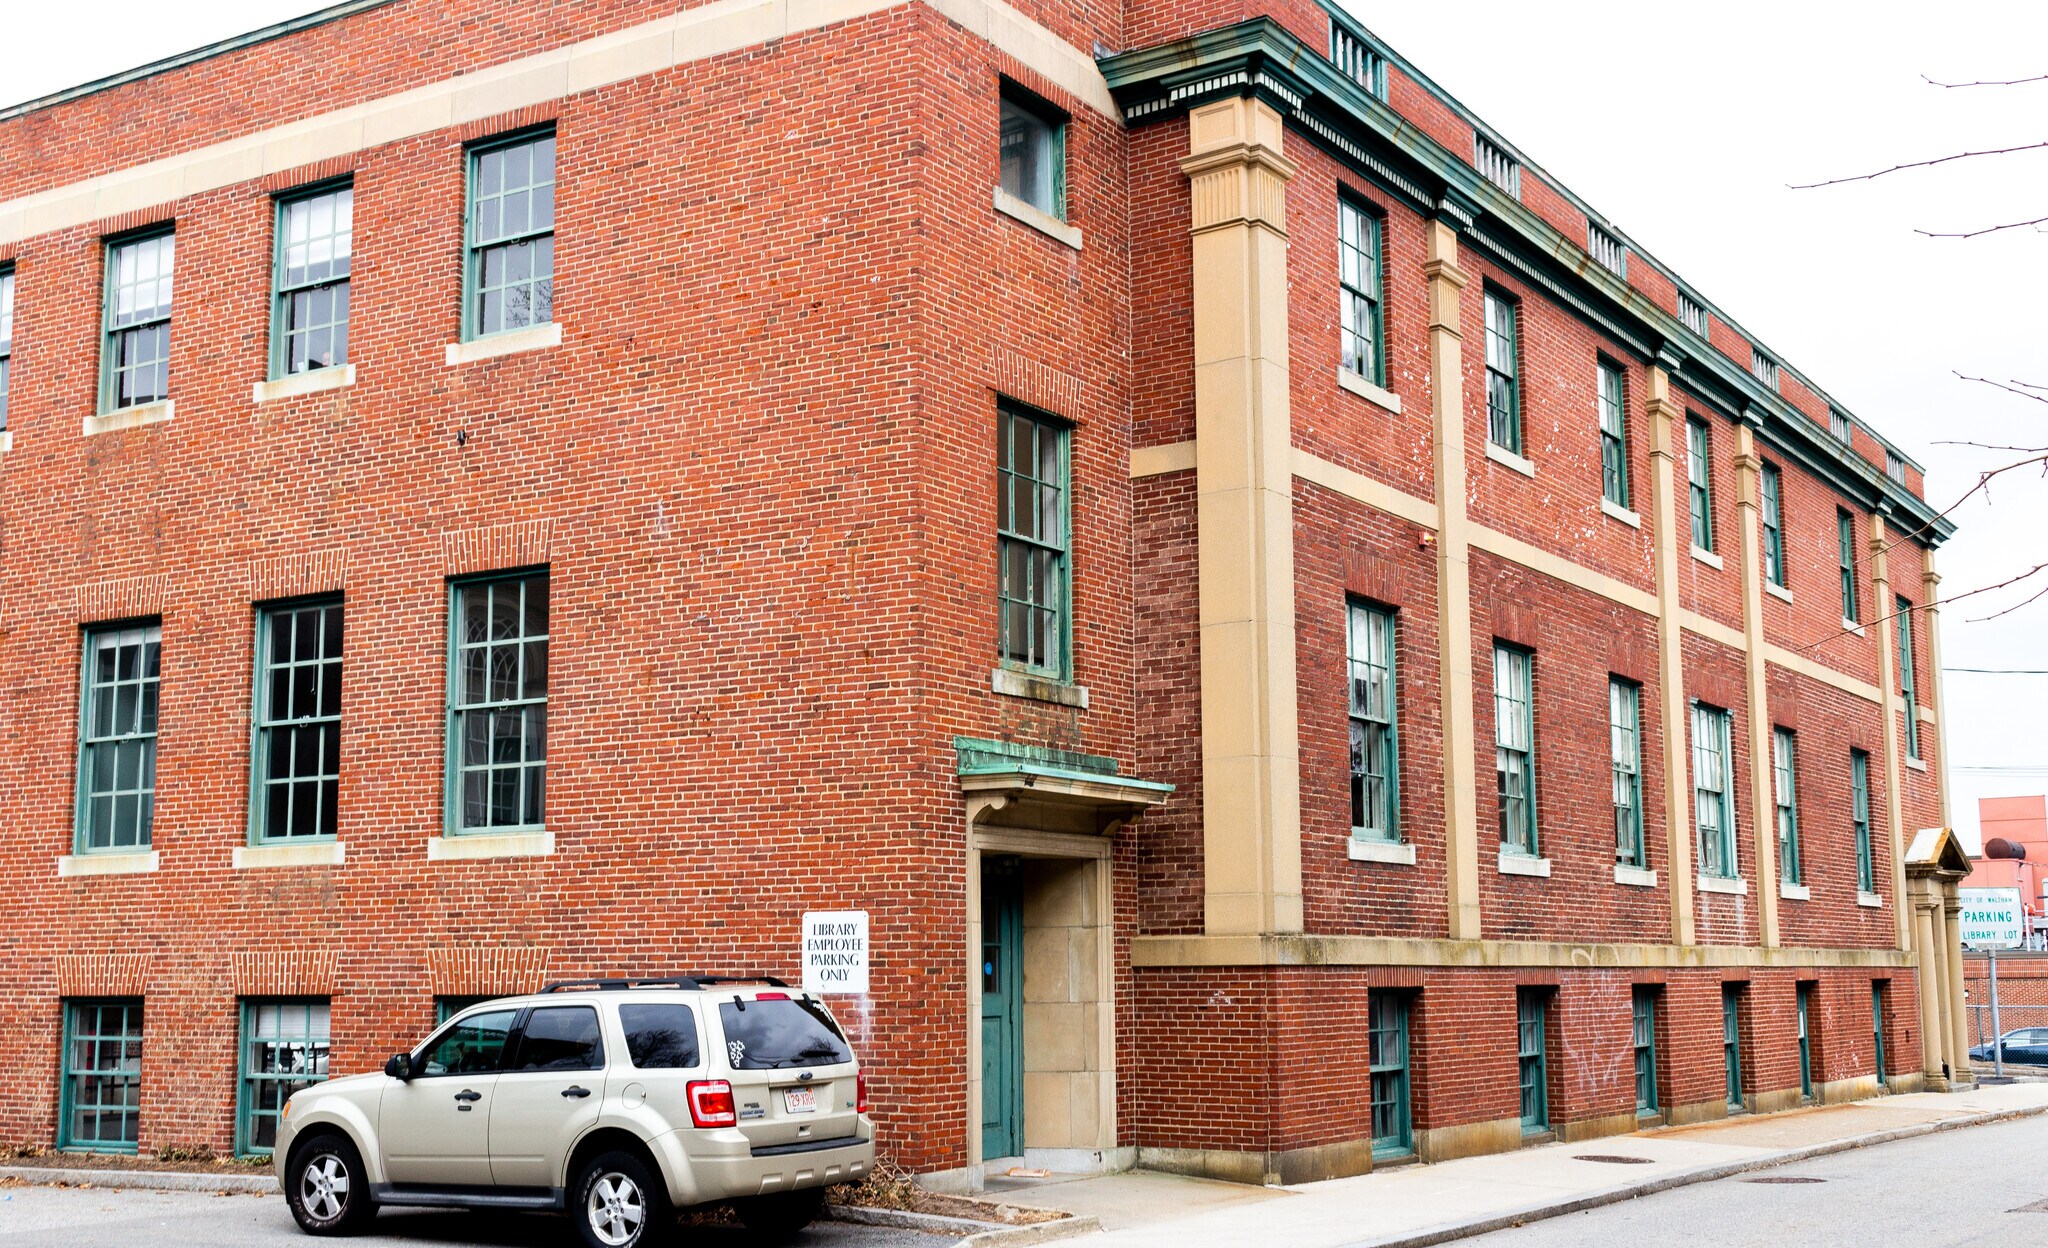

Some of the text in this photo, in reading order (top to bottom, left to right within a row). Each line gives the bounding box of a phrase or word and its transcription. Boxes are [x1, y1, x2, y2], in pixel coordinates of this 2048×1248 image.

[1964, 911, 2012, 923] PARKING
[813, 923, 858, 936] LIBRARY
[1963, 930, 2018, 940] LIBRARY LOT
[808, 938, 863, 951] EMPLOYEE
[811, 953, 859, 966] PARKING
[820, 969, 850, 981] ONLY
